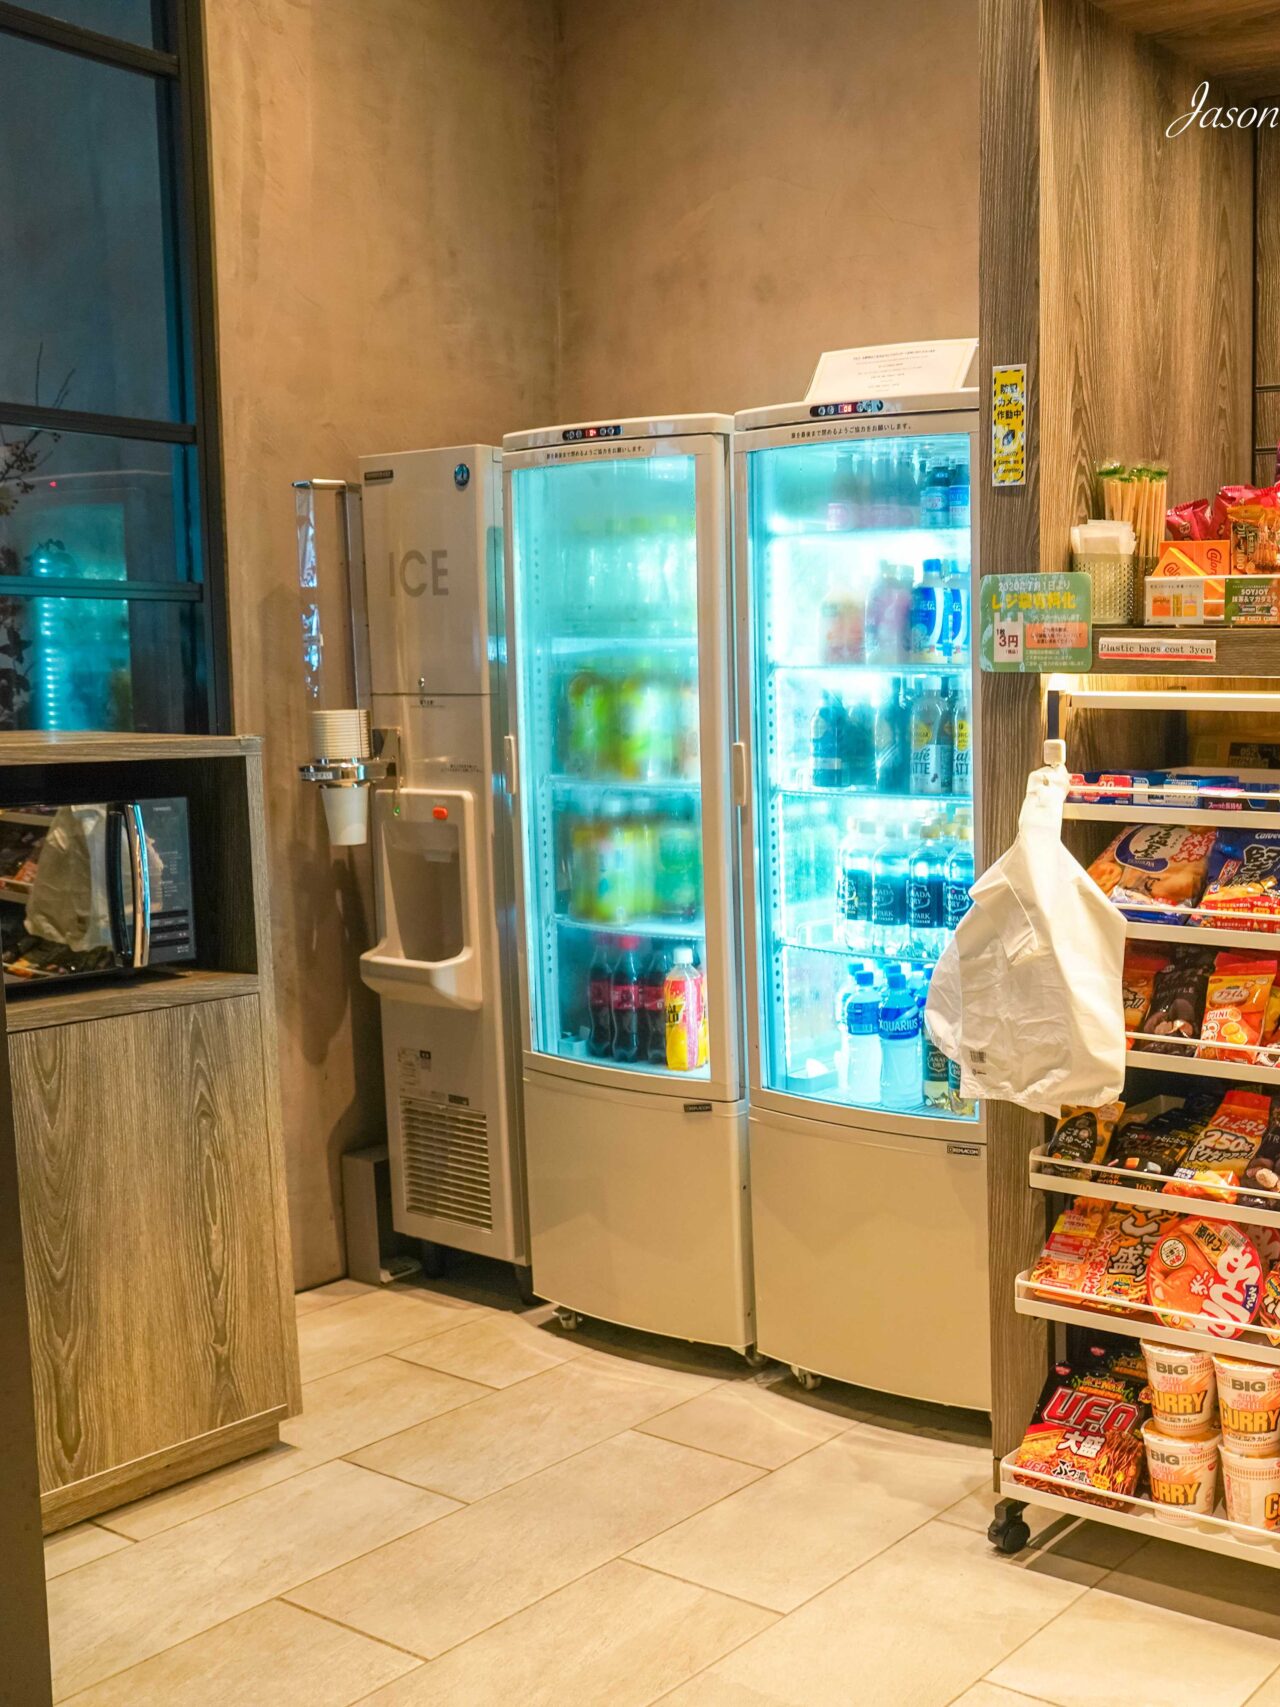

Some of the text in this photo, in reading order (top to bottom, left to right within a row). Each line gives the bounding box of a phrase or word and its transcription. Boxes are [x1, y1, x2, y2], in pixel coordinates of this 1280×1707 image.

[389, 549, 450, 597] ICE
[1240, 588, 1269, 596] SOYJOY
[1100, 642, 1213, 656] Plastic bags cost 3yen
[1156, 1362, 1189, 1376] BIG
[1231, 1379, 1266, 1393] BIG
[1055, 1431, 1107, 1459] 大盛
[1151, 1448, 1180, 1466] BIG
